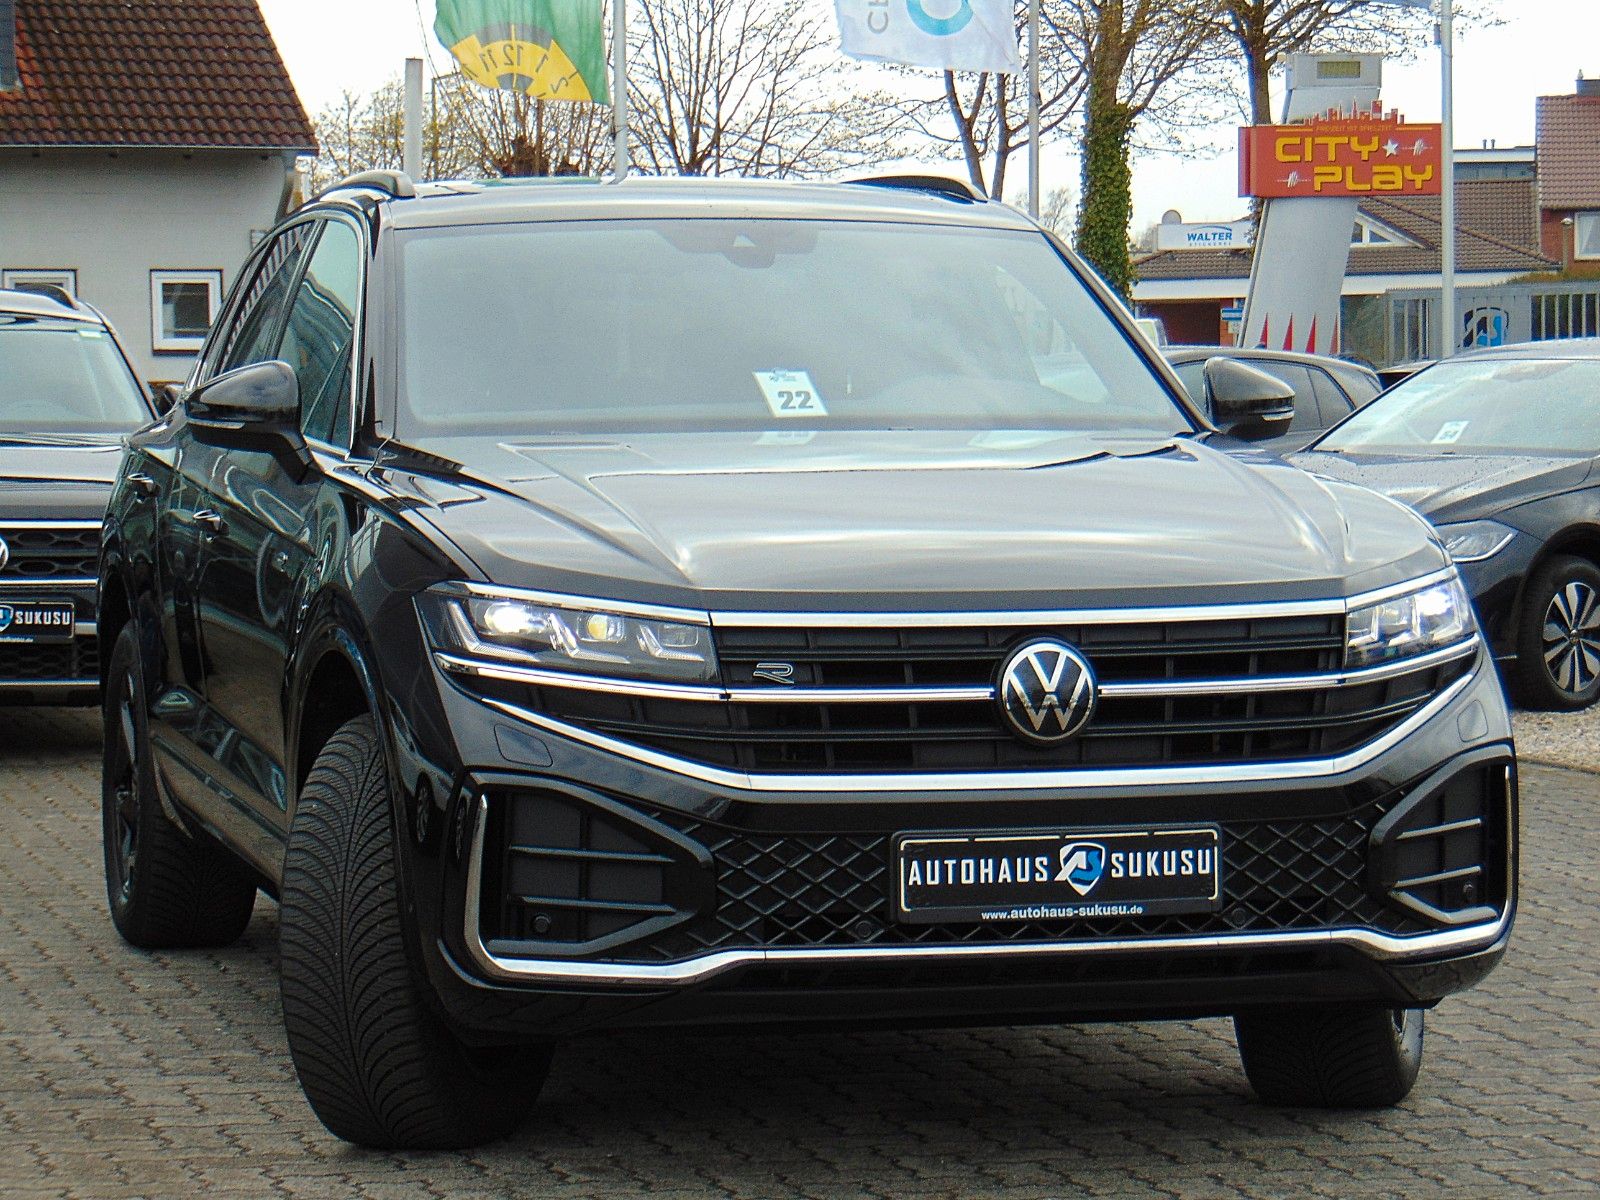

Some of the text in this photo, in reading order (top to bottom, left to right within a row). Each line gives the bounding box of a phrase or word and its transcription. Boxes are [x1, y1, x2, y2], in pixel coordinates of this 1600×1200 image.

[1275, 136, 1379, 163] CITY
[1187, 232, 1232, 242] WALTER
[777, 390, 814, 410] 22
[15, 611, 71, 625] SUKUSU
[908, 856, 1049, 886] AUTOHAUS
[1111, 849, 1211, 879] SUKUSU
[981, 904, 1144, 920] www.autohaus-sukusu.de
